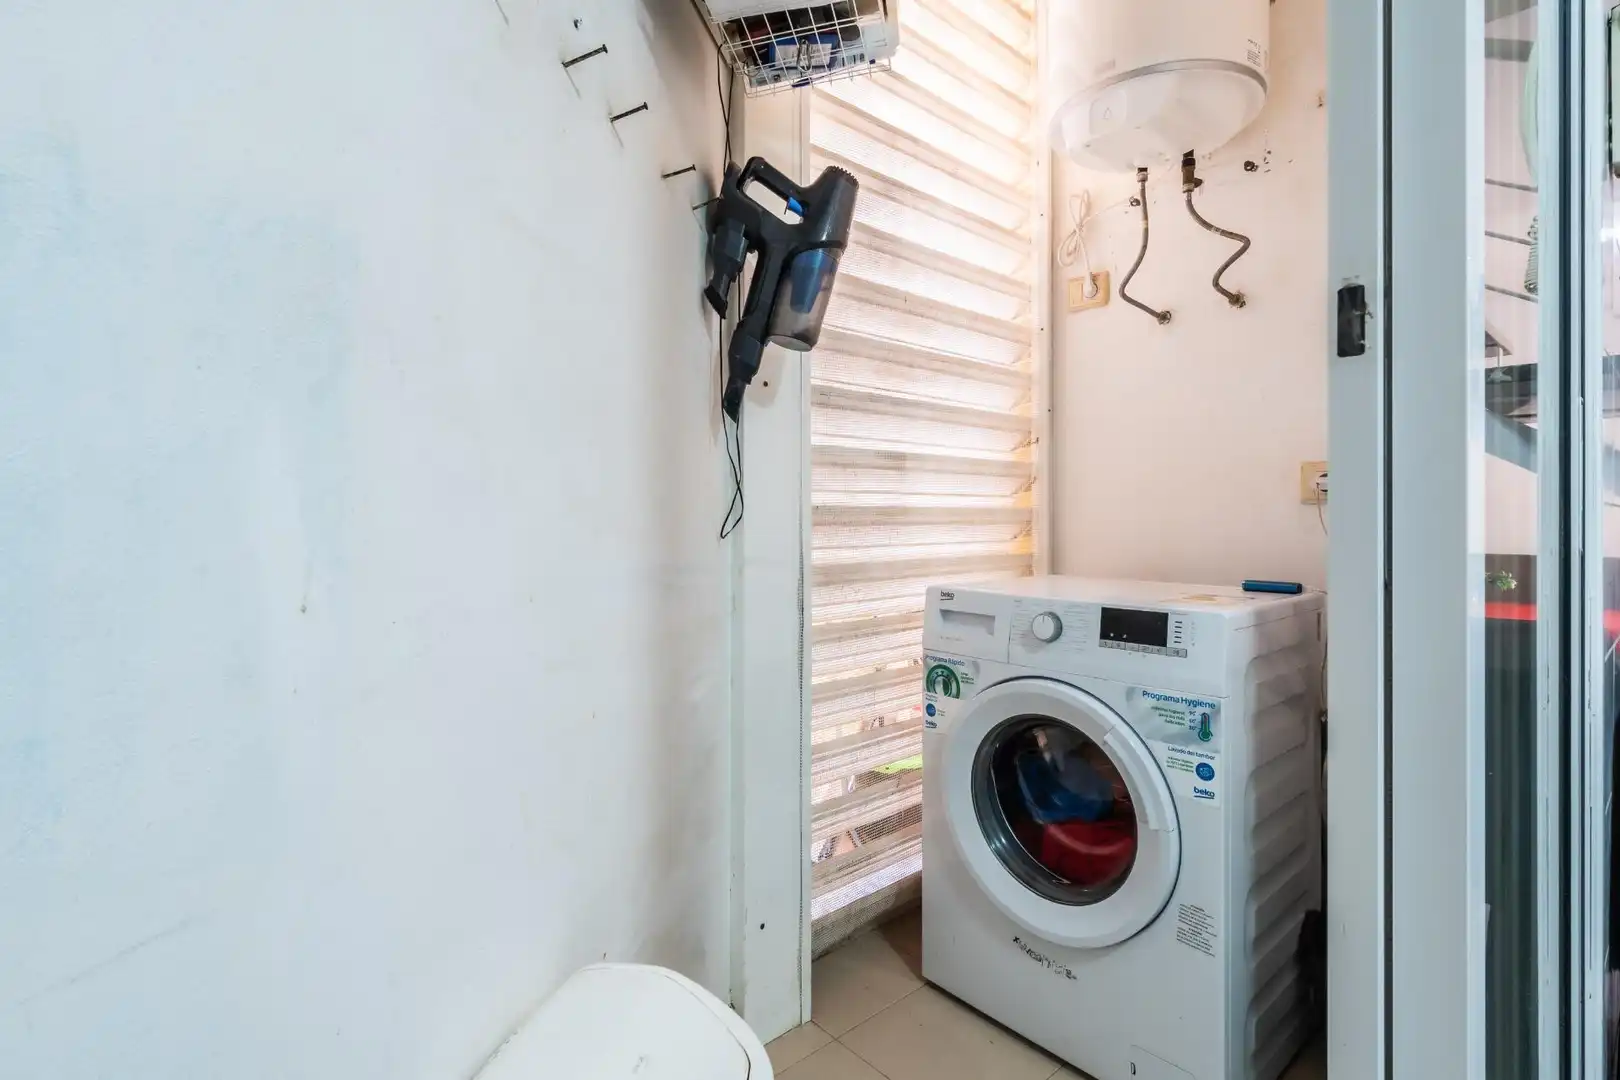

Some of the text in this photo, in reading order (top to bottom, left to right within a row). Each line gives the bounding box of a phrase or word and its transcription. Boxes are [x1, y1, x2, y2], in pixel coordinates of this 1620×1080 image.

[940, 590, 955, 599] beko
[1142, 690, 1180, 702] Programa
[1180, 696, 1217, 710] Hygiene
[1194, 786, 1216, 798] beko
